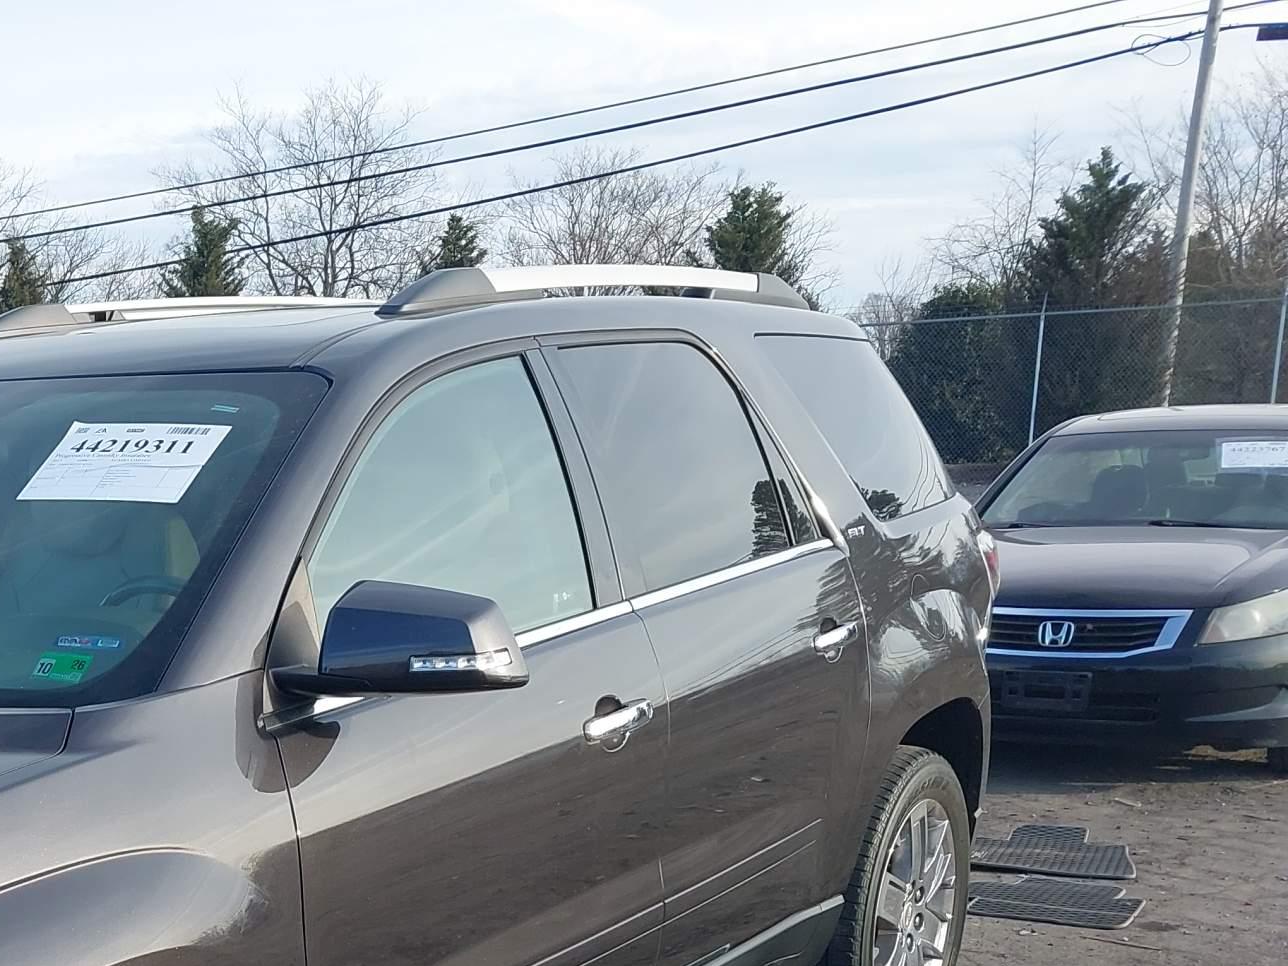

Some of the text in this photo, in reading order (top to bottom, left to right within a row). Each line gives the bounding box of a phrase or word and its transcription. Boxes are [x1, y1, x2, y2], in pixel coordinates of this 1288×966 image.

[71, 439, 194, 454] 44219311
[37, 659, 86, 675] 10 26
